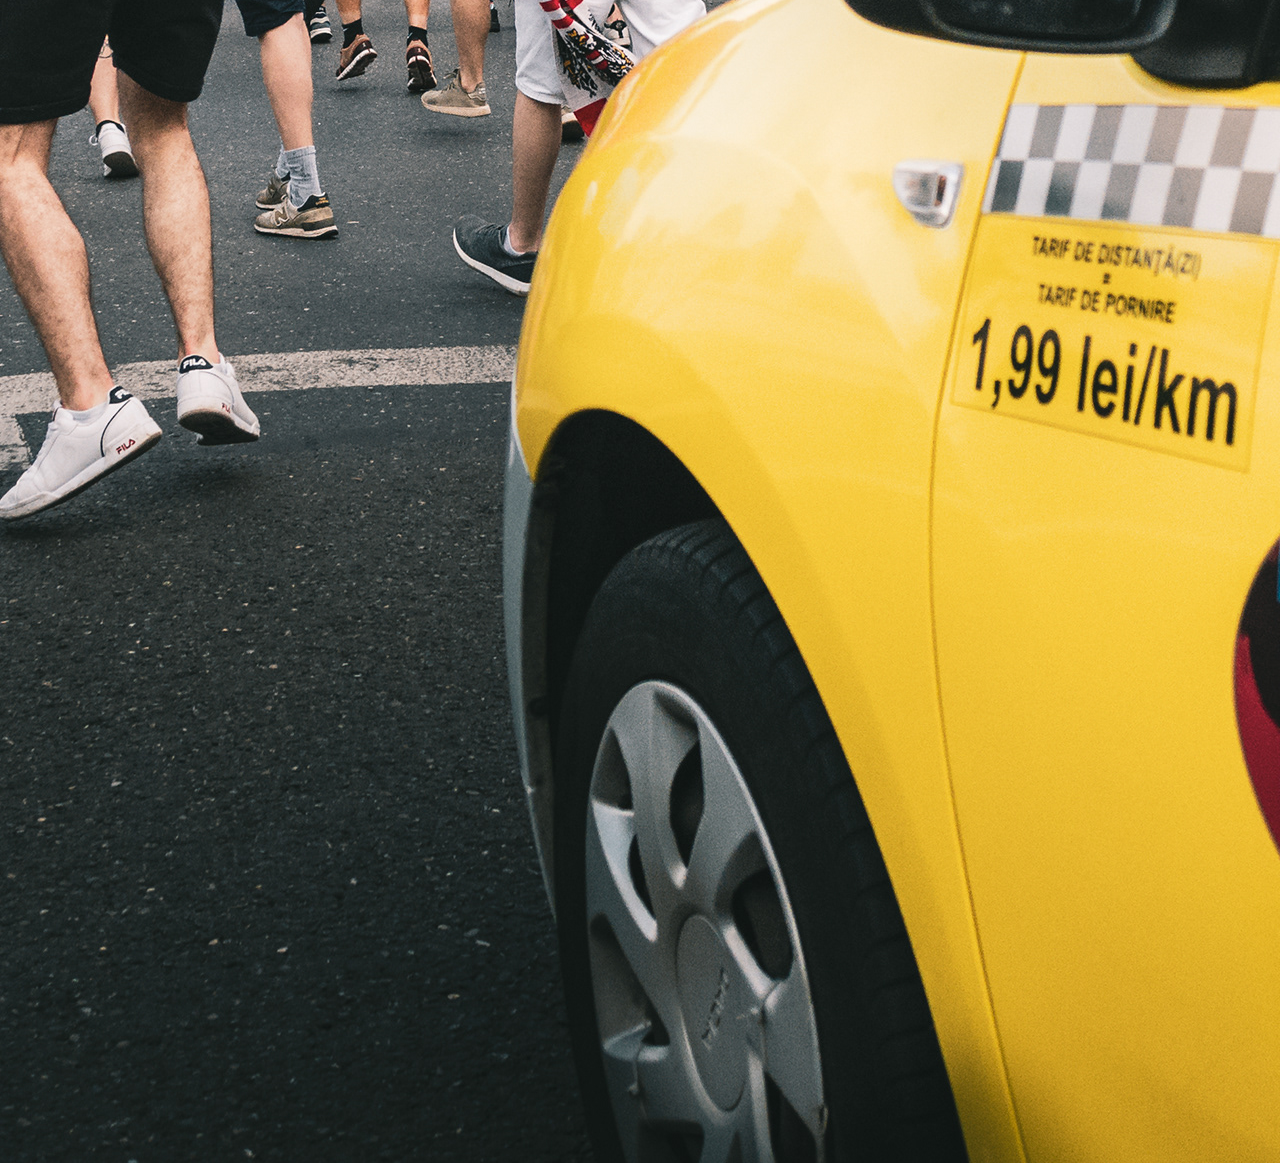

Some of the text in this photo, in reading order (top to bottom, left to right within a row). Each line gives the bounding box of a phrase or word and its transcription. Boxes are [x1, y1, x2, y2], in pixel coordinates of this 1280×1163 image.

[1033, 236, 1070, 258] TARIF
[1074, 241, 1094, 263] DE
[1040, 284, 1177, 324] TARIF DE PORNIRE
[183, 358, 207, 369] FILA
[973, 317, 1238, 446] 1,99 lei/km
[115, 438, 136, 455] FILA
